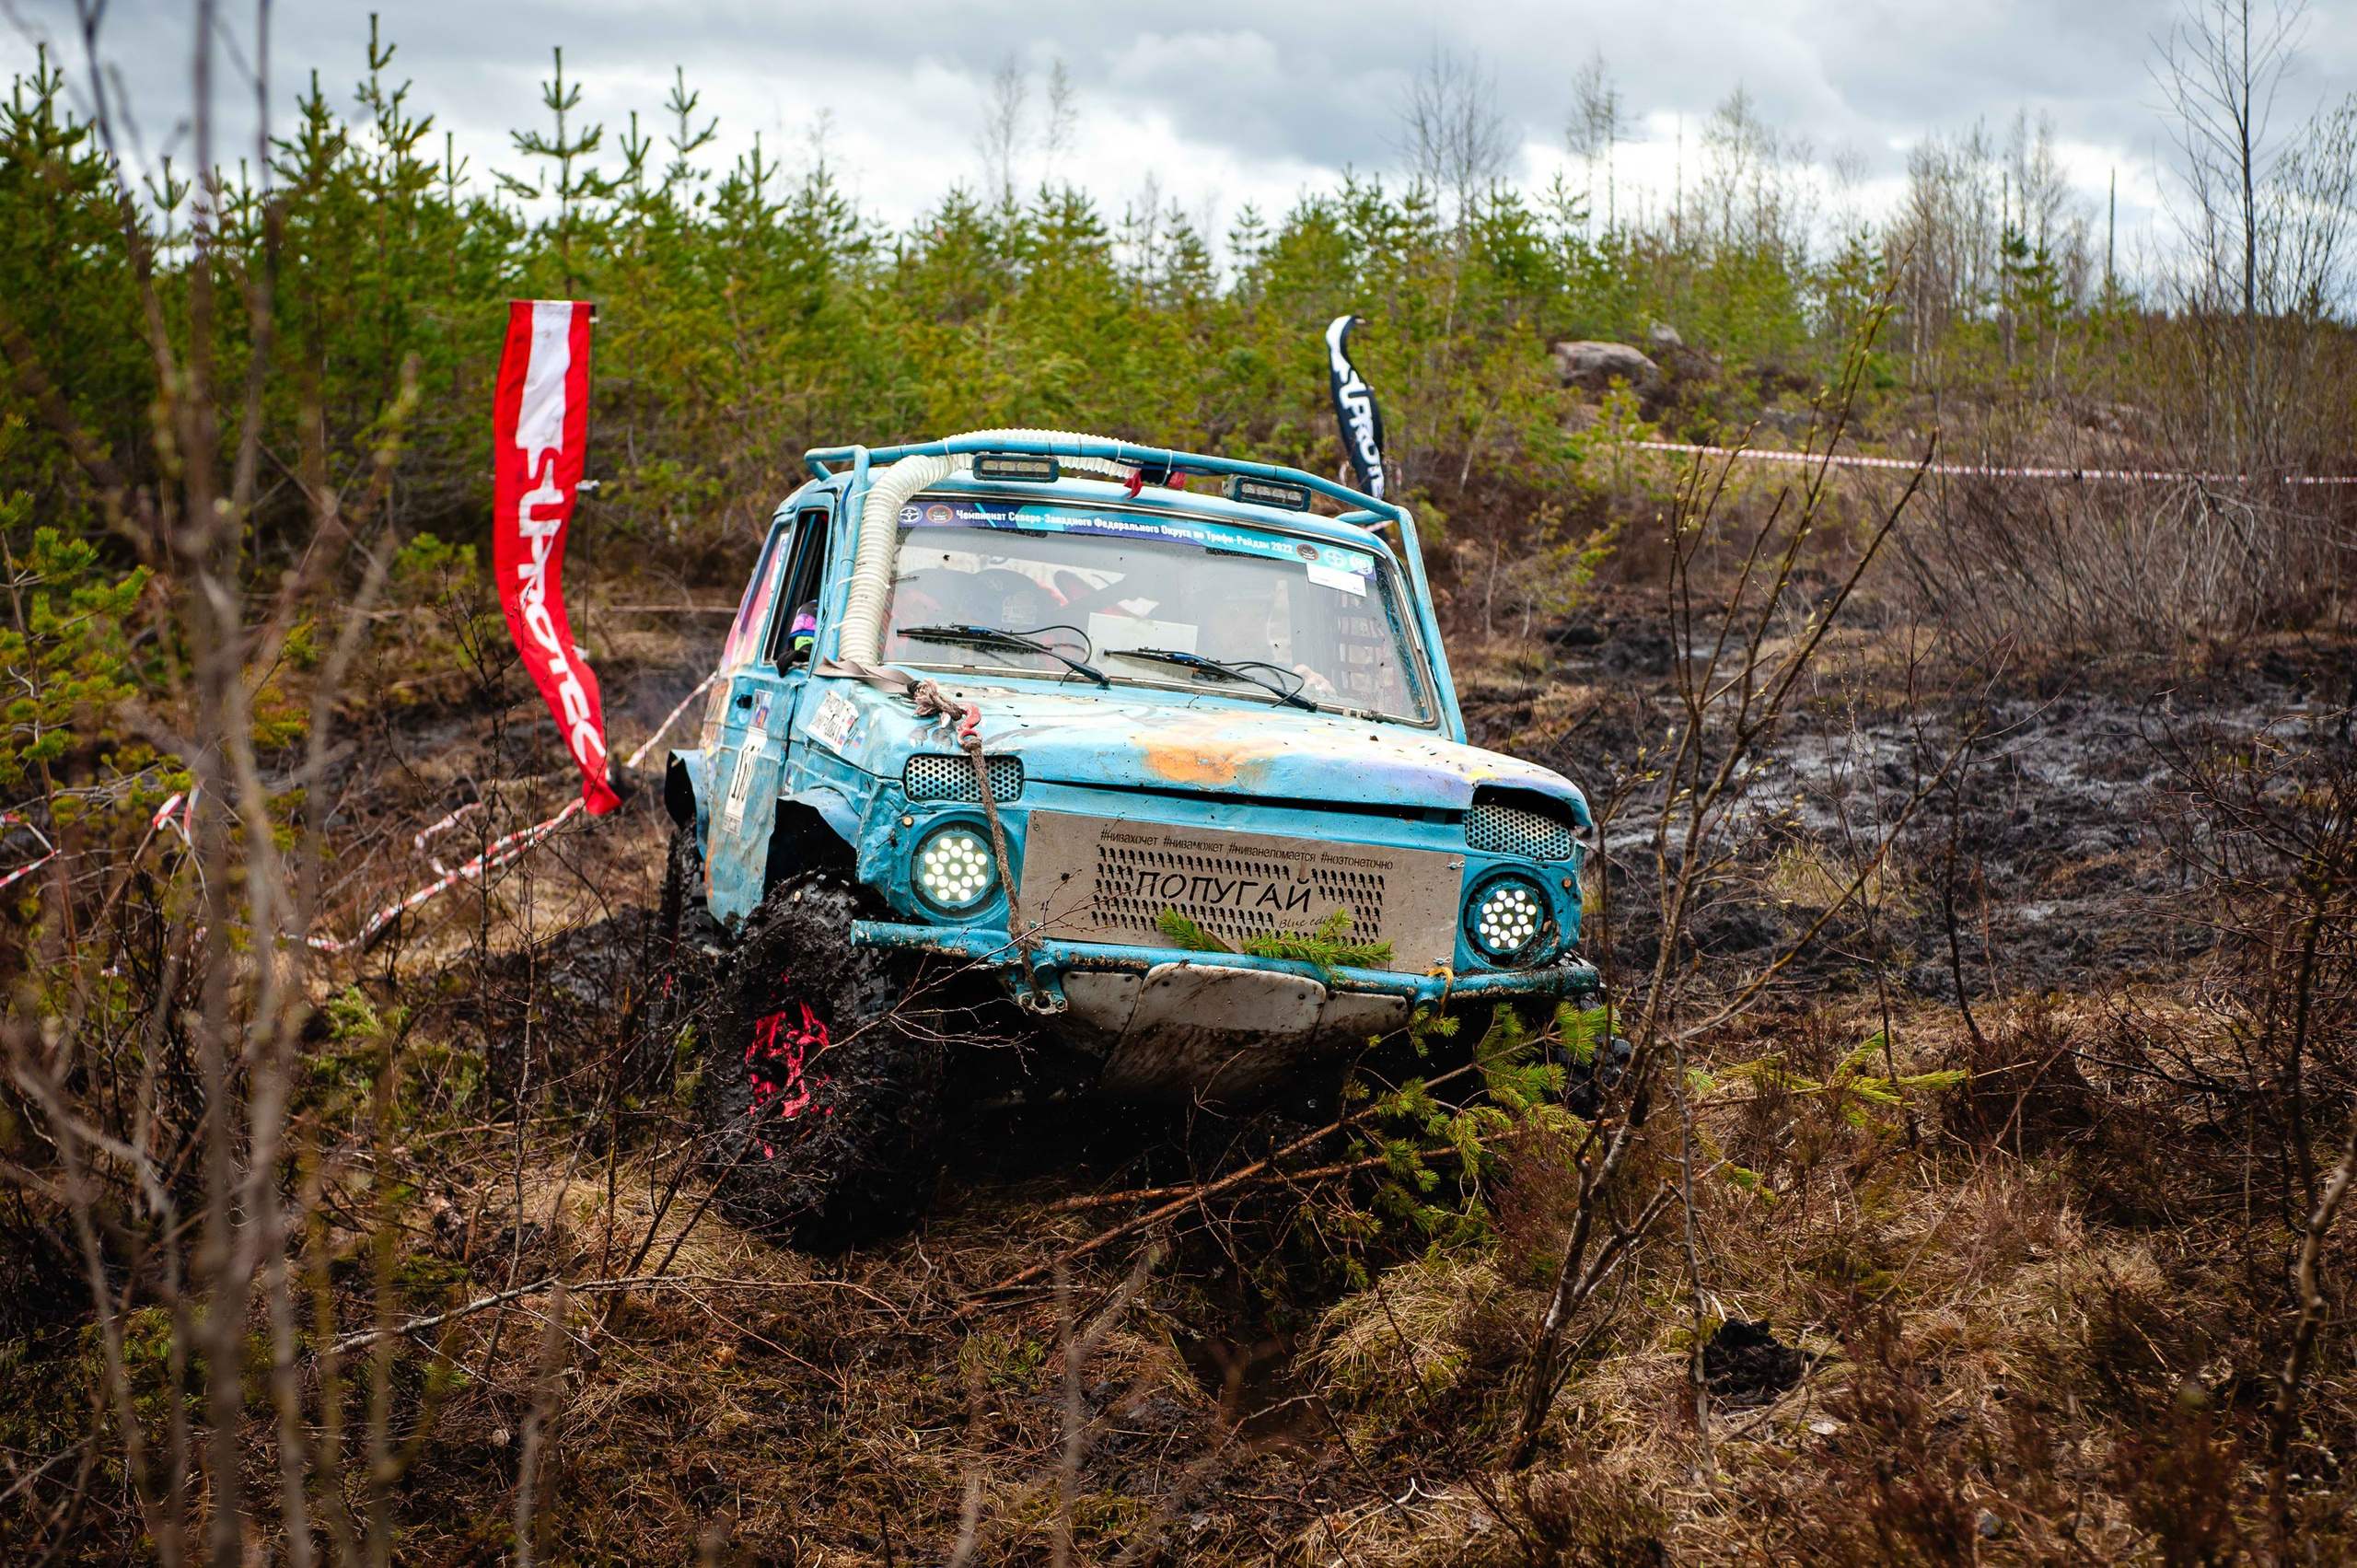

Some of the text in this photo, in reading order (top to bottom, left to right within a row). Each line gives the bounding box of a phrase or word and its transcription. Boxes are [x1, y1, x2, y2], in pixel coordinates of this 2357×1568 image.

[956, 508, 1006, 521] Чемпионат
[1008, 511, 1093, 528] Северо-Западного
[1094, 517, 1160, 534] Федерального
[1160, 524, 1192, 539] Округа
[1206, 530, 1270, 550] Трофи-Рейдам
[1271, 541, 1294, 554] 2022
[1100, 829, 1394, 870] #нивахочет #ниваможет #ниванеломается #ноэтонеточно
[1135, 870, 1312, 913] ПОПУГАЙ
[1279, 918, 1307, 929] Blue
